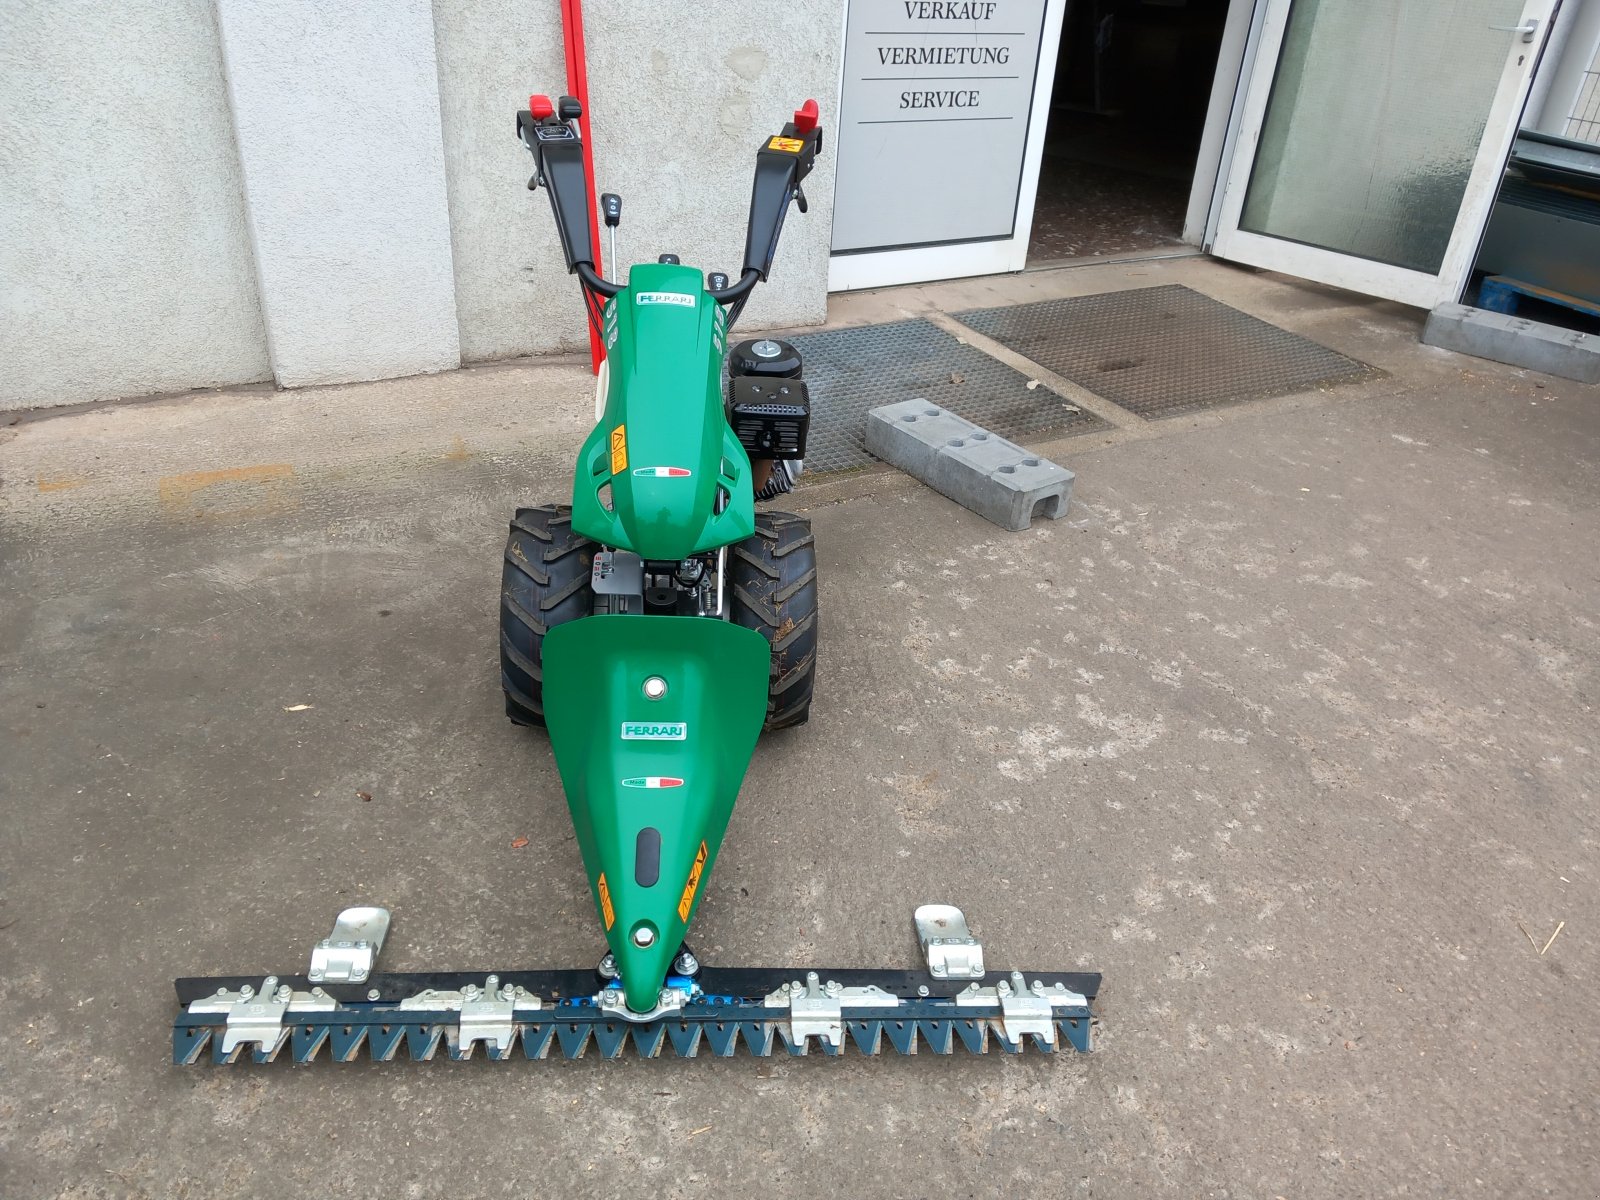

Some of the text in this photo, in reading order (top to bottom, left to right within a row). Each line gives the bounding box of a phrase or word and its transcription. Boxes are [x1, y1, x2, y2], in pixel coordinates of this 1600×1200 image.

[904, 1, 997, 20] VERKAUF
[877, 47, 1010, 66] VERMIETUNG
[899, 90, 980, 109] SERVICE
[640, 295, 692, 304] FERRARI
[626, 726, 682, 736] FERRARI
